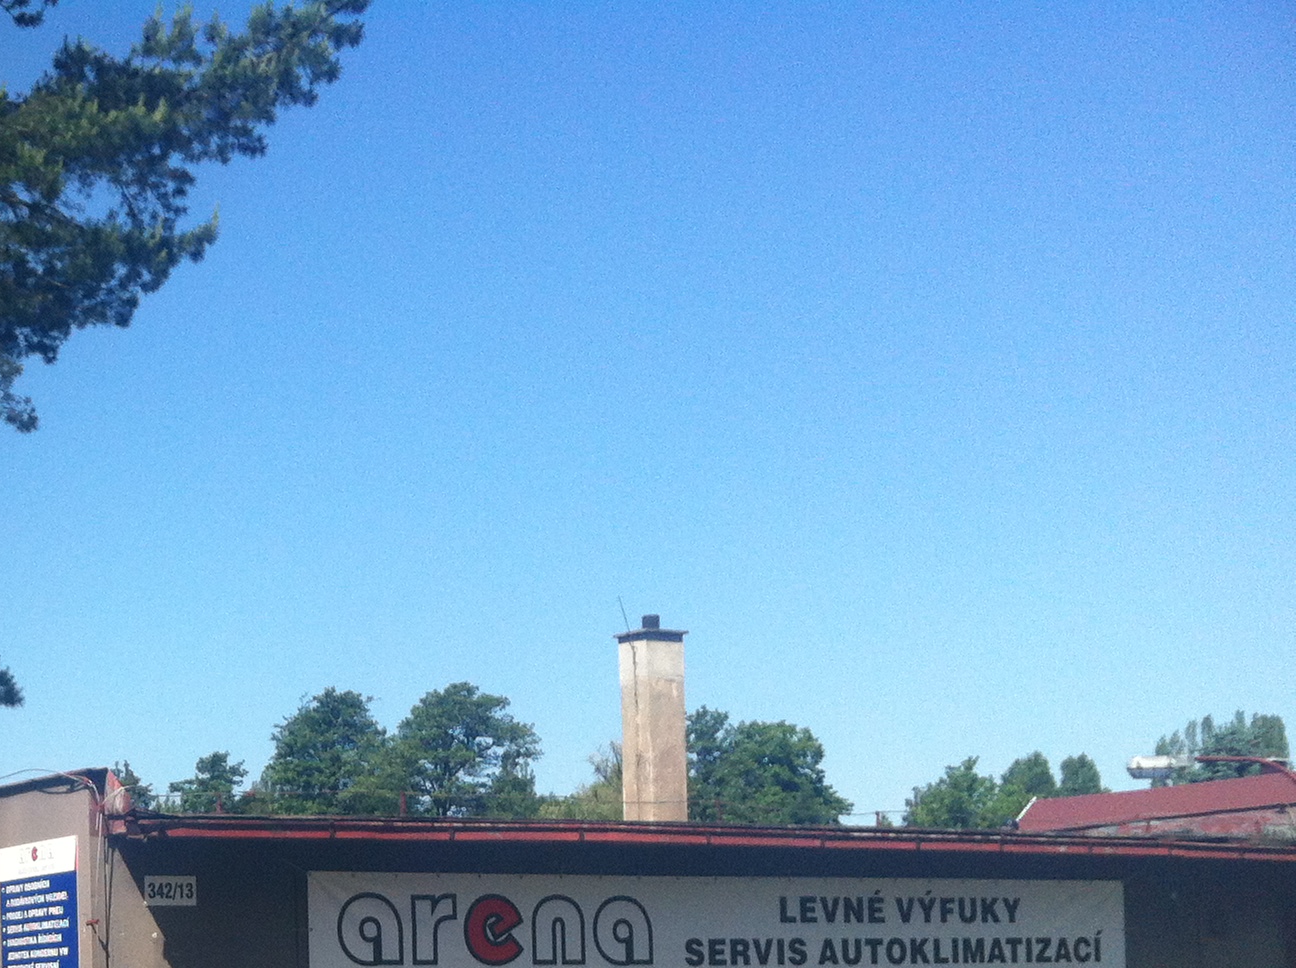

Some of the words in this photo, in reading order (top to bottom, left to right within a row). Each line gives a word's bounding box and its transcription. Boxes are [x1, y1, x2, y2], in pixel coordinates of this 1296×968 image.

[147, 882, 194, 900] 342/13
[779, 889, 886, 924] LEVNÉ
[897, 889, 1021, 923] VÝFUKY
[337, 892, 654, 967] arena
[685, 938, 808, 966] SERVIS
[819, 930, 1103, 964] AUTOKLIMATIZACÍ
